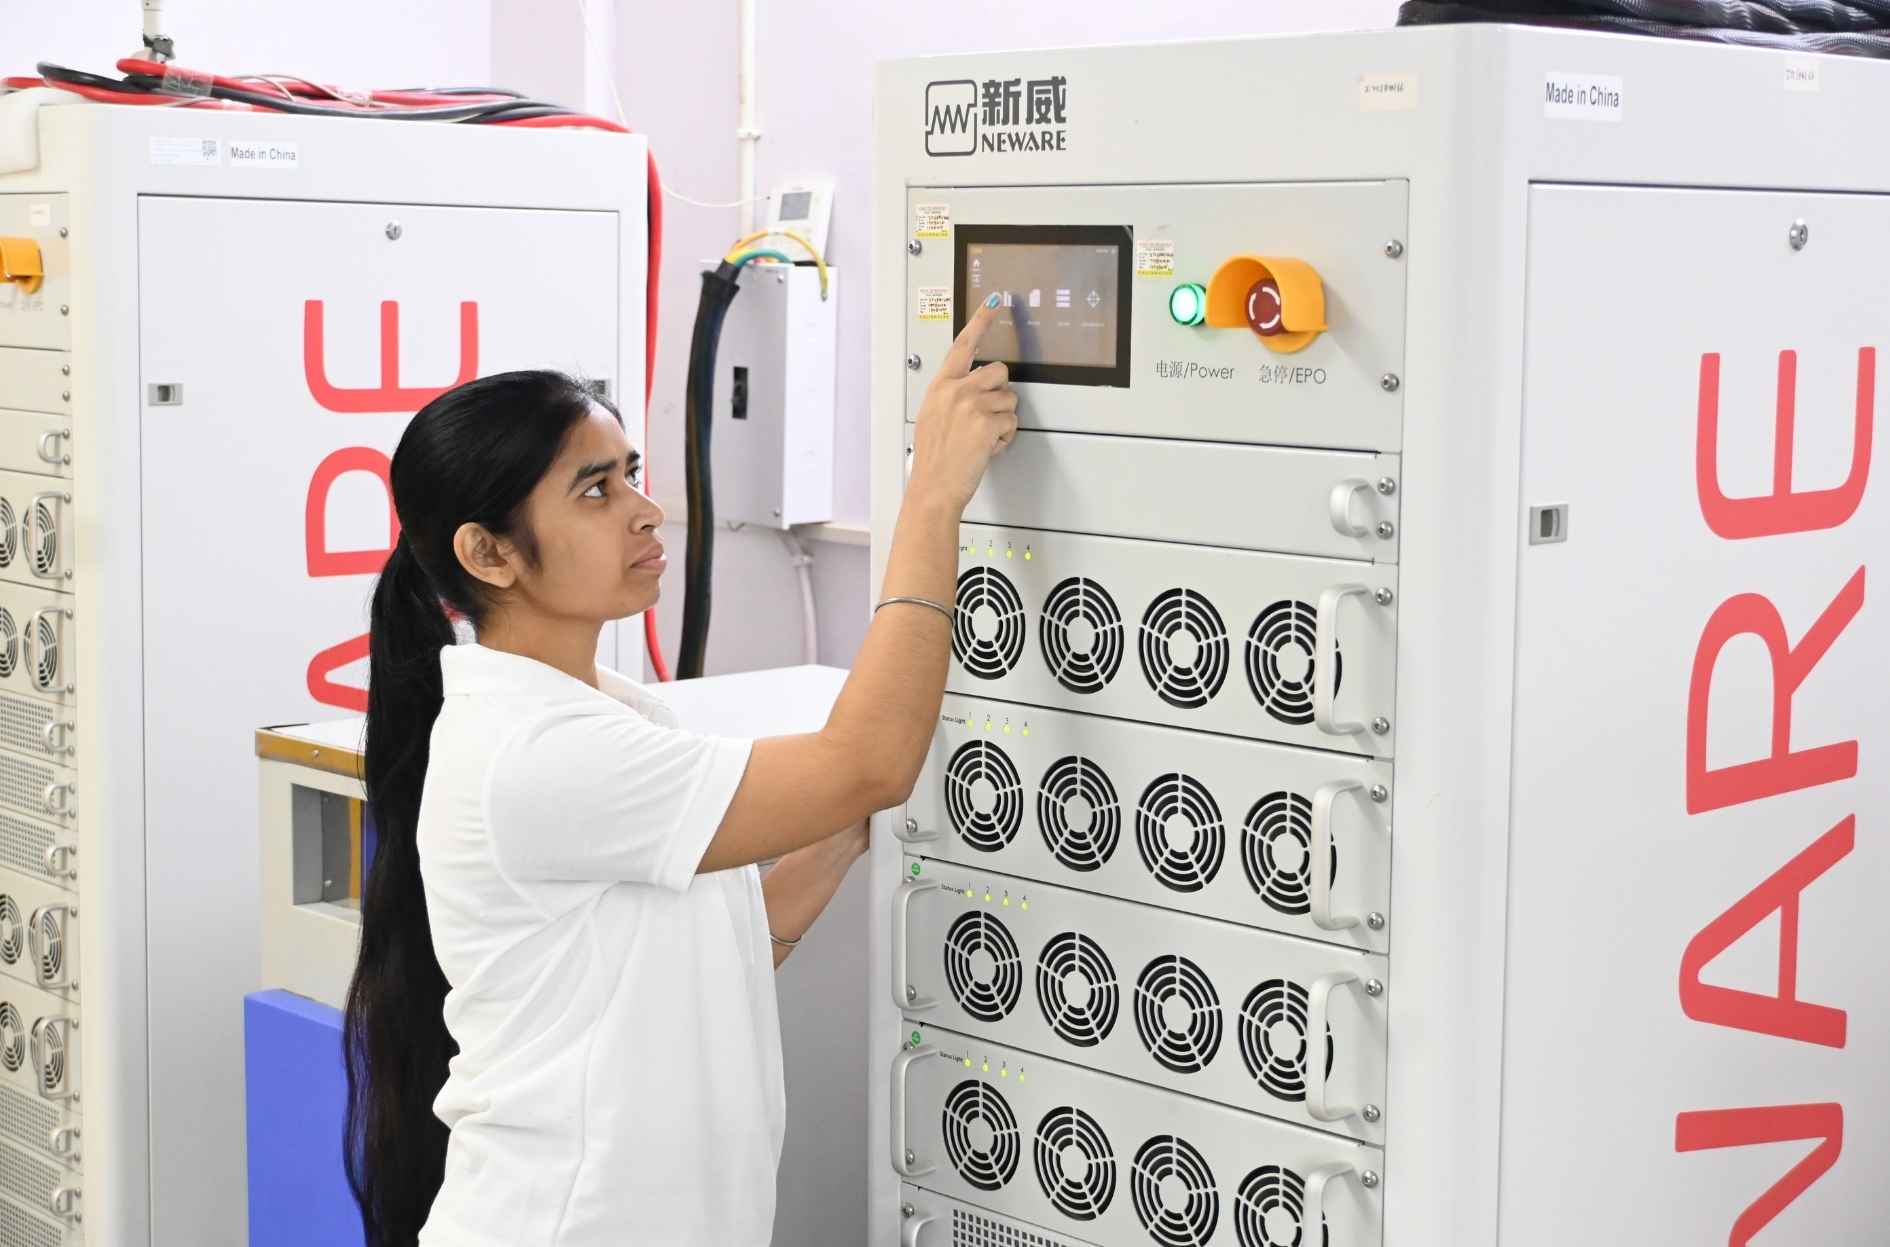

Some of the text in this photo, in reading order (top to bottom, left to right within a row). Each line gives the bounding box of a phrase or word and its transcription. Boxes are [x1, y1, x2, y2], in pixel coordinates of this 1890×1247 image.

[982, 76, 1067, 126] 新威
[1545, 81, 1620, 109] Made in China
[982, 130, 1067, 153] NEWARE
[231, 147, 297, 161] Made in China
[1156, 359, 1236, 380] 电源/Power
[1258, 364, 1328, 385] 急停/EPO
